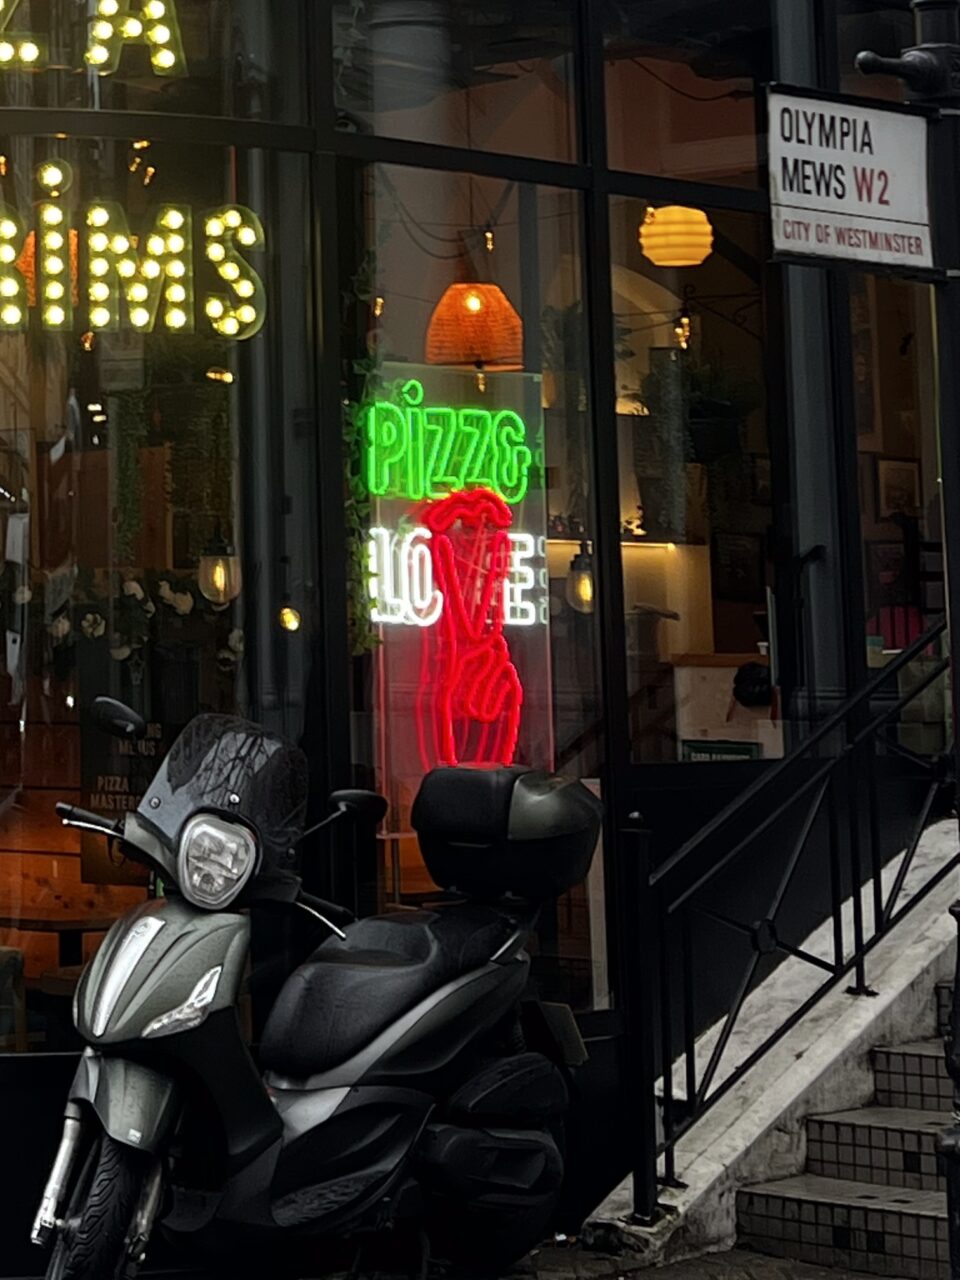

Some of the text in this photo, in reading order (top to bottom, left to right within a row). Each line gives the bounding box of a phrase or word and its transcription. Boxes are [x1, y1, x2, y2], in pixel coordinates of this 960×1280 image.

[780, 107, 874, 155] OLYMPIA
[781, 156, 890, 206] MEWS W2
[783, 219, 924, 256] CITY OF WESTMINSTER
[97, 776, 130, 793] PIZZA
